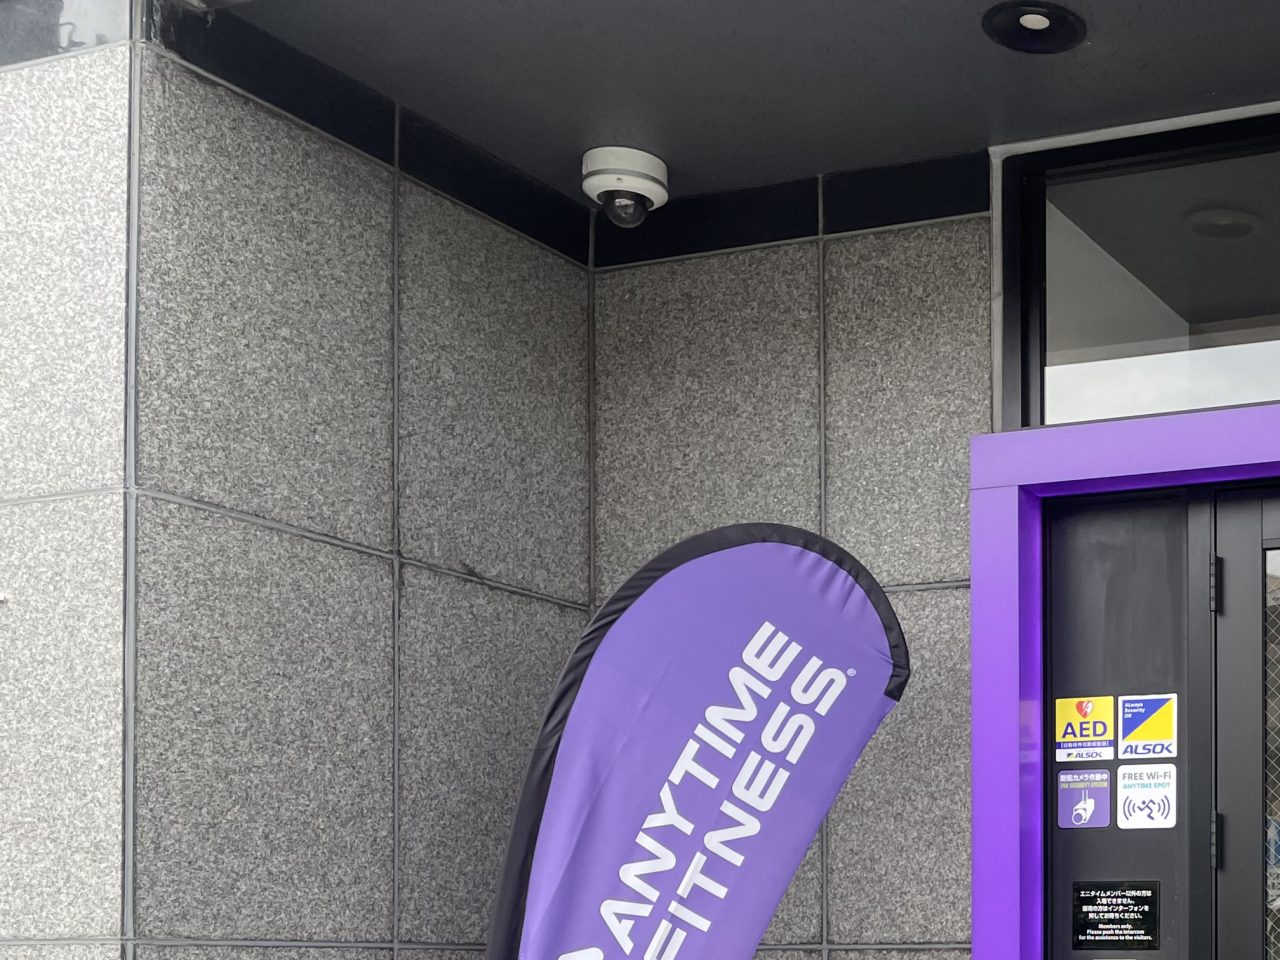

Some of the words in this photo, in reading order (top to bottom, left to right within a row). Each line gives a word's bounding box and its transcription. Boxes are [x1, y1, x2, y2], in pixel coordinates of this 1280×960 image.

[1061, 720, 1108, 739] AED
[1122, 743, 1173, 756] ALSOK
[1122, 772, 1144, 781] FREE
[1146, 770, 1172, 780] Wi-Fi
[600, 620, 803, 955] ANYTIME
